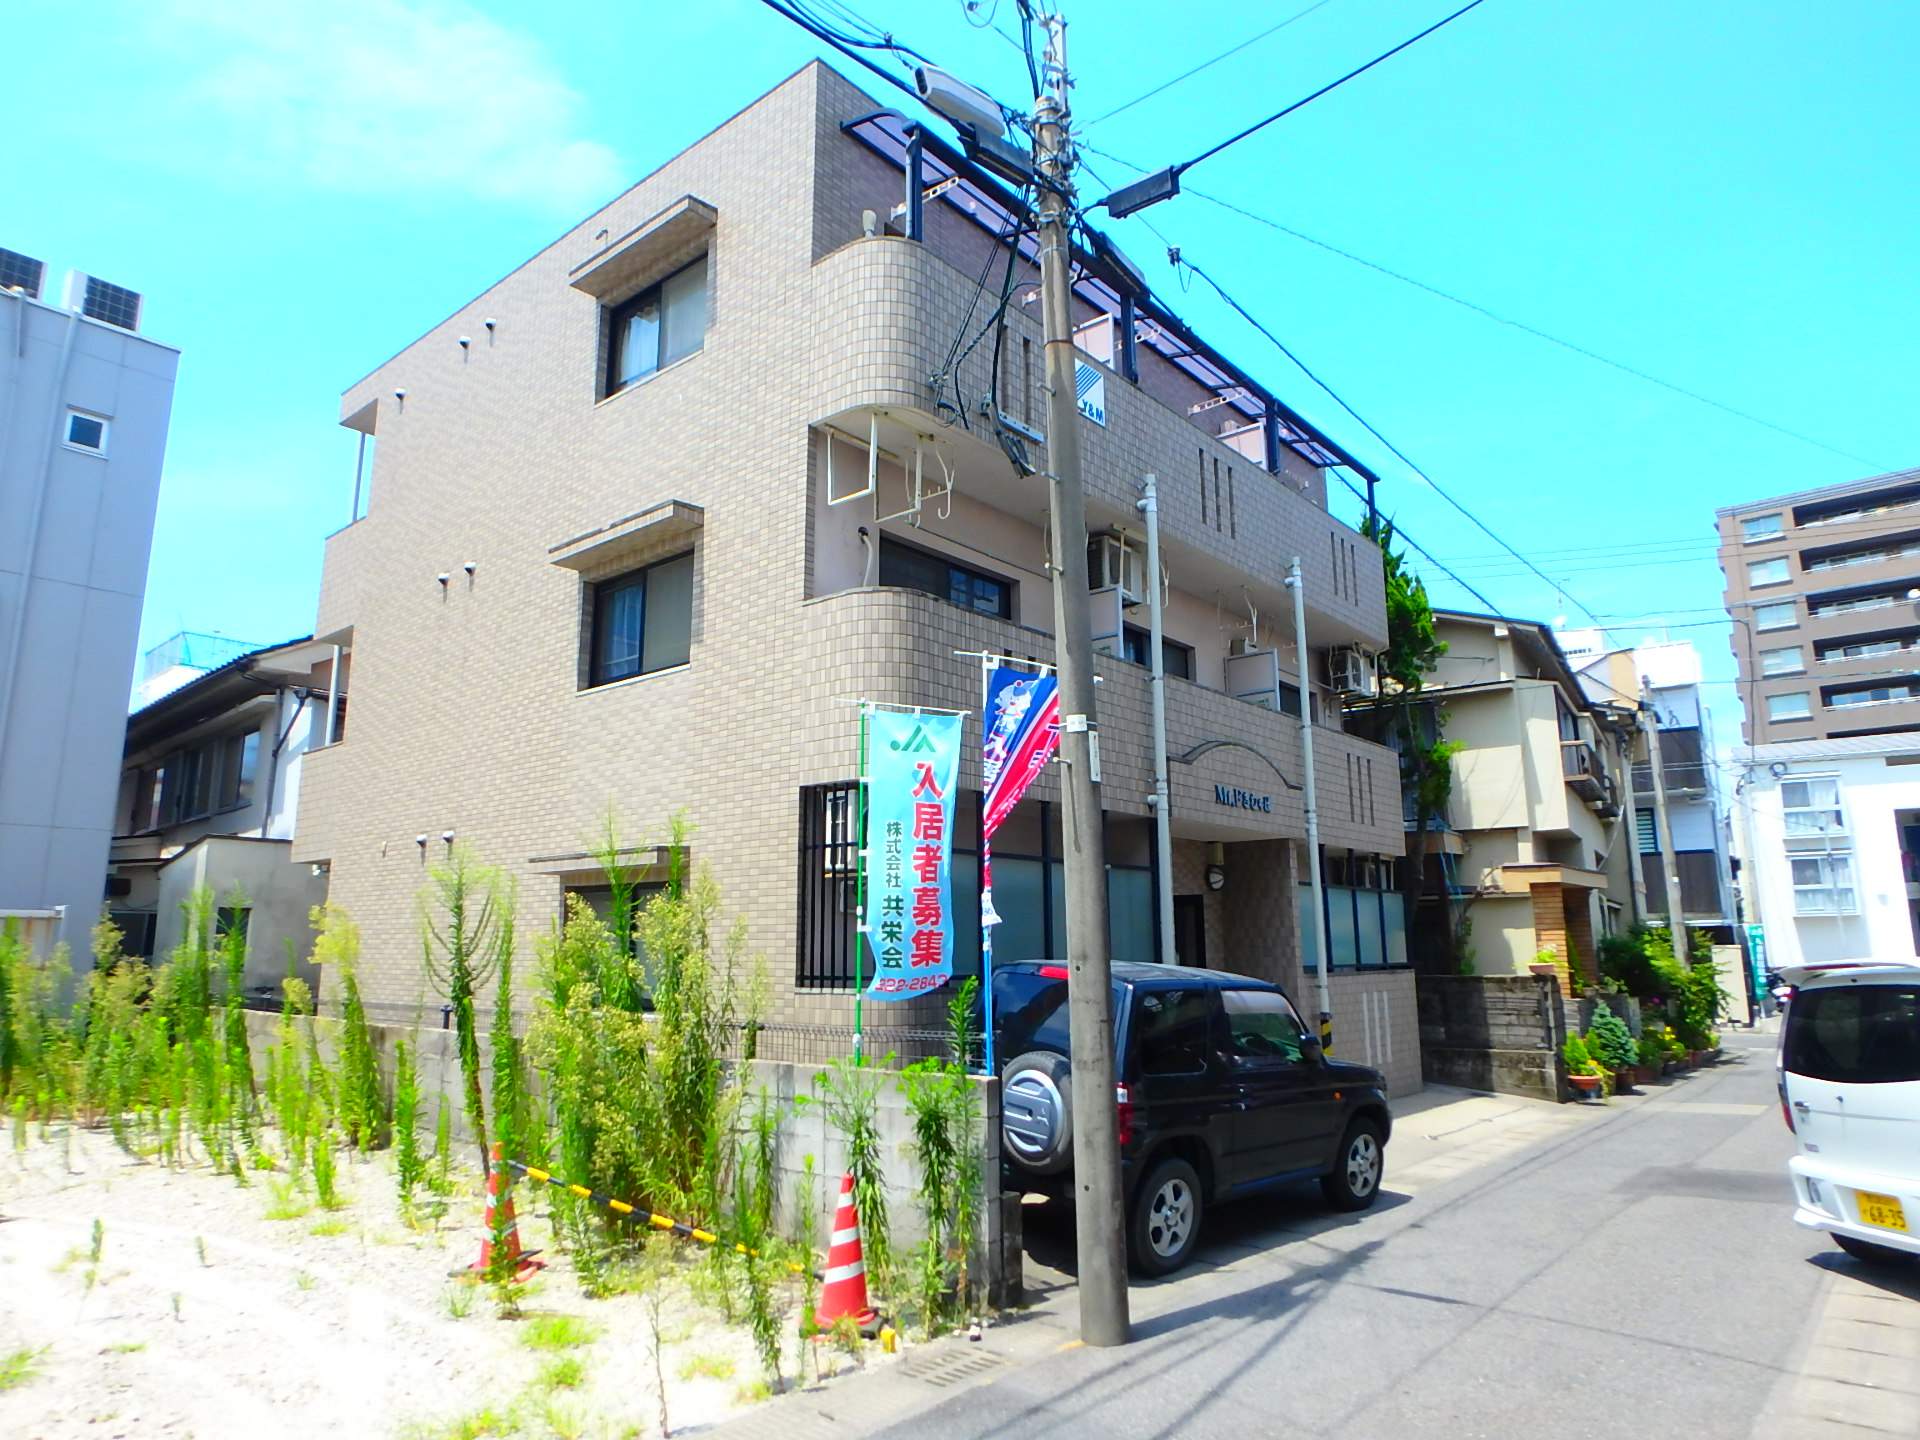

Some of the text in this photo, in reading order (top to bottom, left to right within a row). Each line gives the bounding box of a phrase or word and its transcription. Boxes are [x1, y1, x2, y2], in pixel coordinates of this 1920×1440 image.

[1082, 399, 1104, 423] Y&M
[911, 762, 944, 967] 入居者募集
